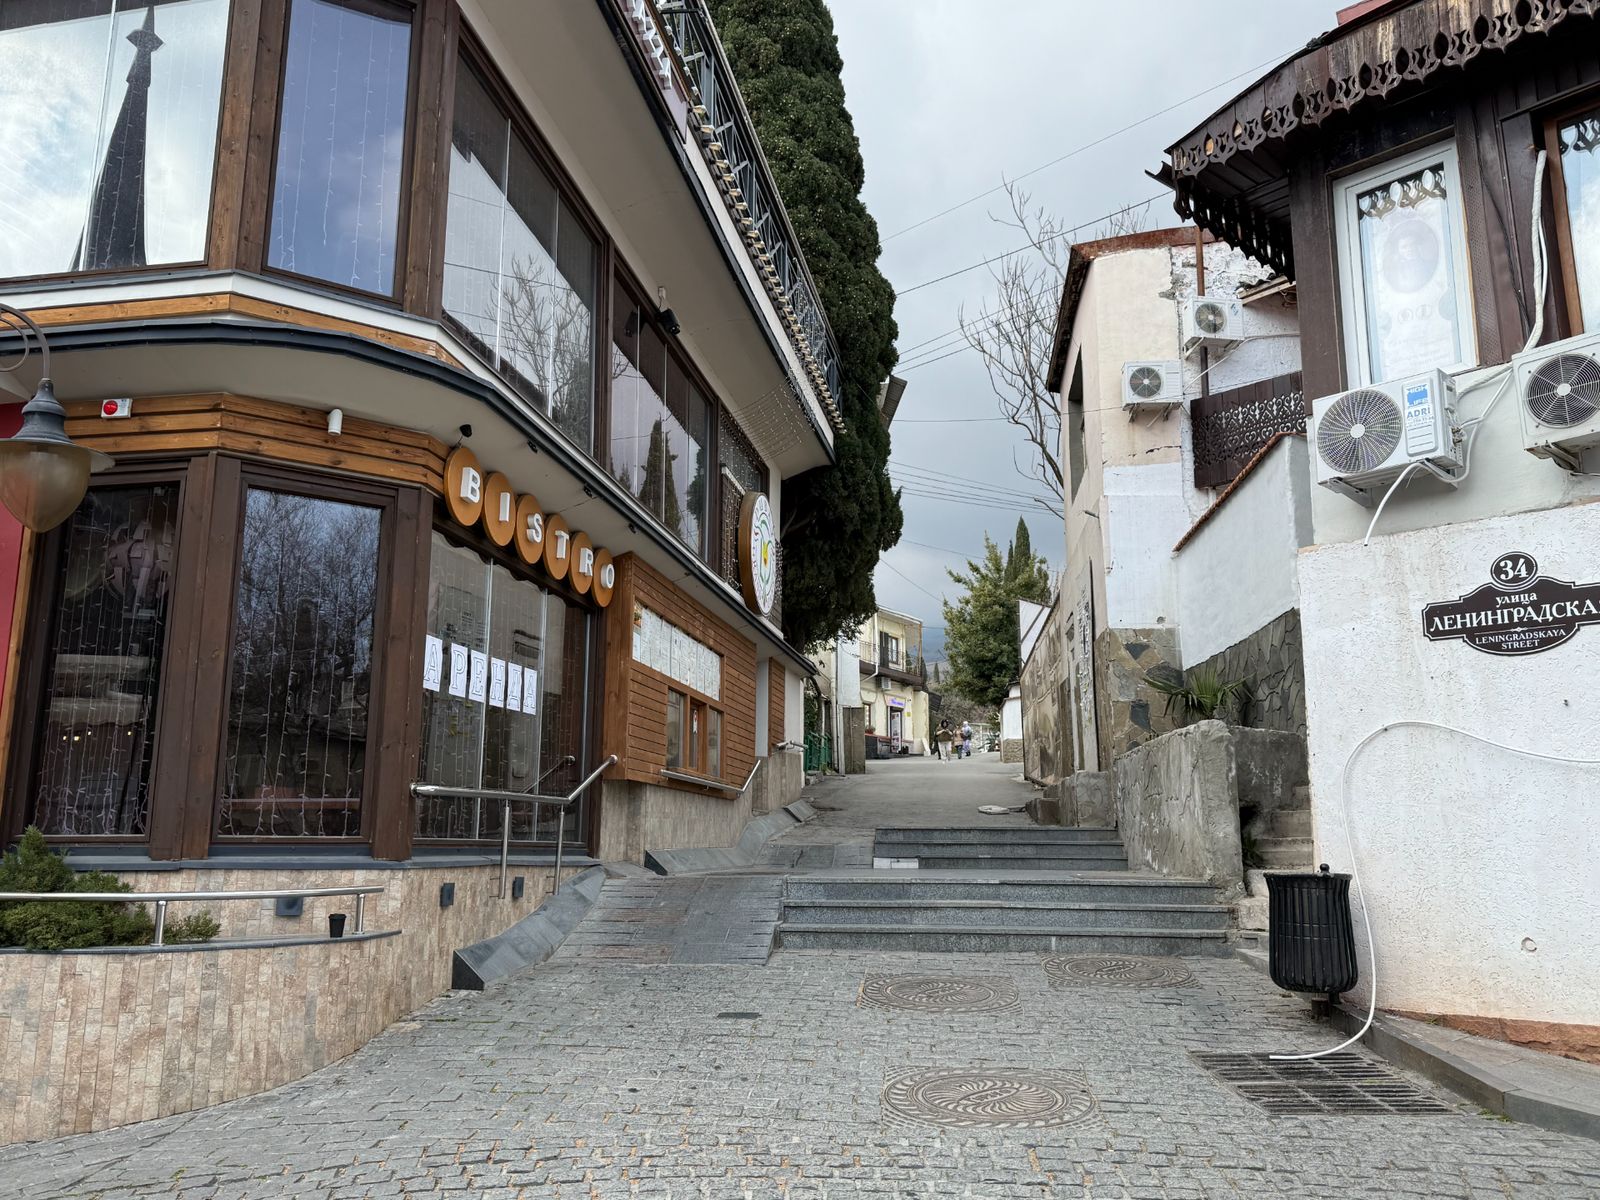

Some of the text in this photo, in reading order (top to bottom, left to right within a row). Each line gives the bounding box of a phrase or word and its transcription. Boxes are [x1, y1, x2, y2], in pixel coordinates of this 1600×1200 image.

[627, 0, 672, 89] AZZA
[460, 466, 615, 590] BISTRO
[1499, 557, 1529, 581] 34
[1495, 592, 1538, 608] улица
[1429, 598, 1600, 632] ЛЕНИНГРАДСКА
[1475, 628, 1566, 645] LENINGRADSKAYA
[1501, 639, 1540, 650] STREET
[424, 643, 537, 710] АРЕНДА
